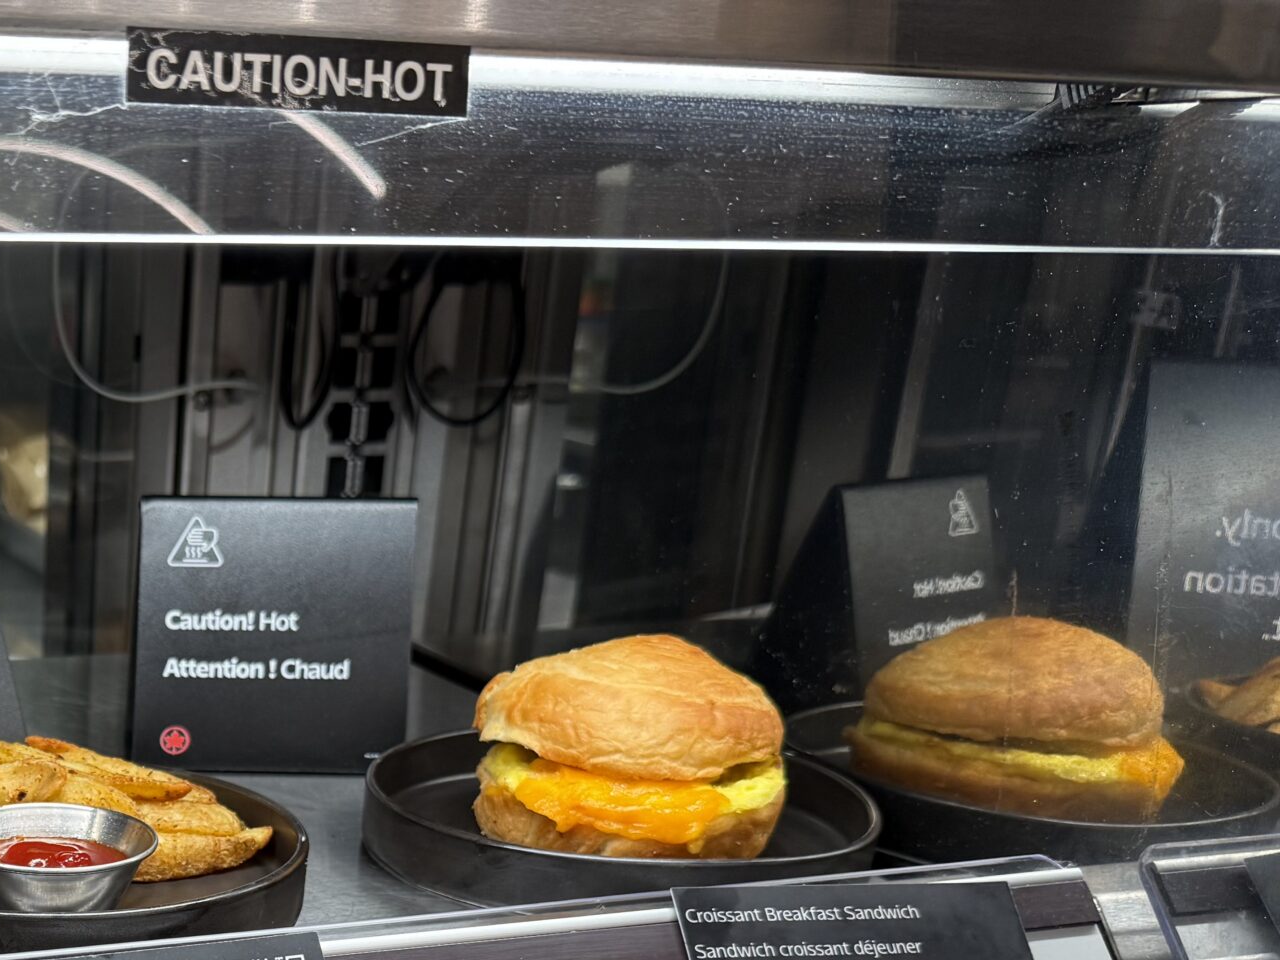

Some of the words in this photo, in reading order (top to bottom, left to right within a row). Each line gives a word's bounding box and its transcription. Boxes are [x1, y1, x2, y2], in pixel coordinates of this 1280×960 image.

[146, 48, 453, 101] CAUTION-HOT
[164, 608, 255, 632] Caution!
[259, 609, 300, 632] Hot
[162, 656, 264, 679] Attention
[268, 659, 277, 679] !
[280, 658, 352, 680] Chaud
[685, 907, 763, 924] Croissant
[766, 906, 844, 922] Breakfast
[845, 904, 921, 920] Sandwich
[694, 942, 775, 959] Sandwich
[779, 941, 852, 957] croissant
[853, 939, 923, 958] déjeuner
